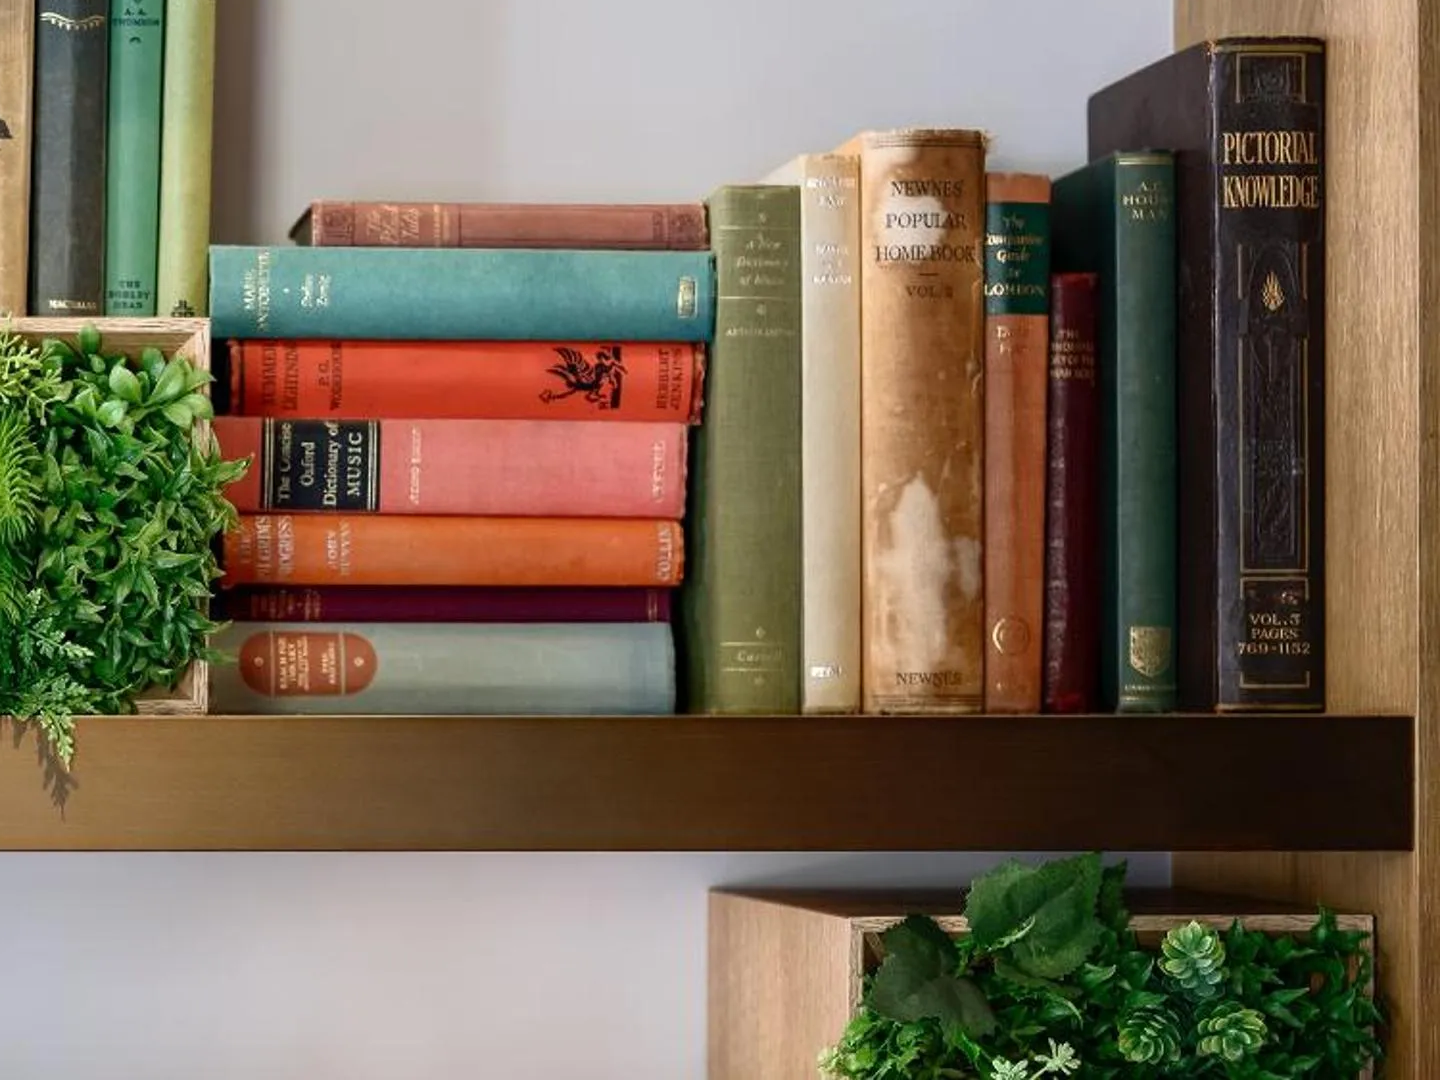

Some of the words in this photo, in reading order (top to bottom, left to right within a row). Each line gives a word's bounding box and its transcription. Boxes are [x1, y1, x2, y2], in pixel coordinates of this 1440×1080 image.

[1222, 131, 1318, 165] PICTORIAL
[891, 180, 964, 198] NEWNES
[1222, 174, 1320, 209] KNOWLEDGE
[885, 212, 967, 230] POPULAR
[983, 282, 1047, 298] LONDON
[670, 349, 682, 410] JENKINS
[323, 422, 339, 436] of
[278, 422, 292, 473] Concise
[300, 441, 315, 487] Oxford
[323, 440, 342, 506] Dictionary
[347, 432, 362, 497] MUSIC
[278, 476, 292, 503] The
[1251, 628, 1298, 639] PAGES
[895, 672, 962, 687] NEWNES
